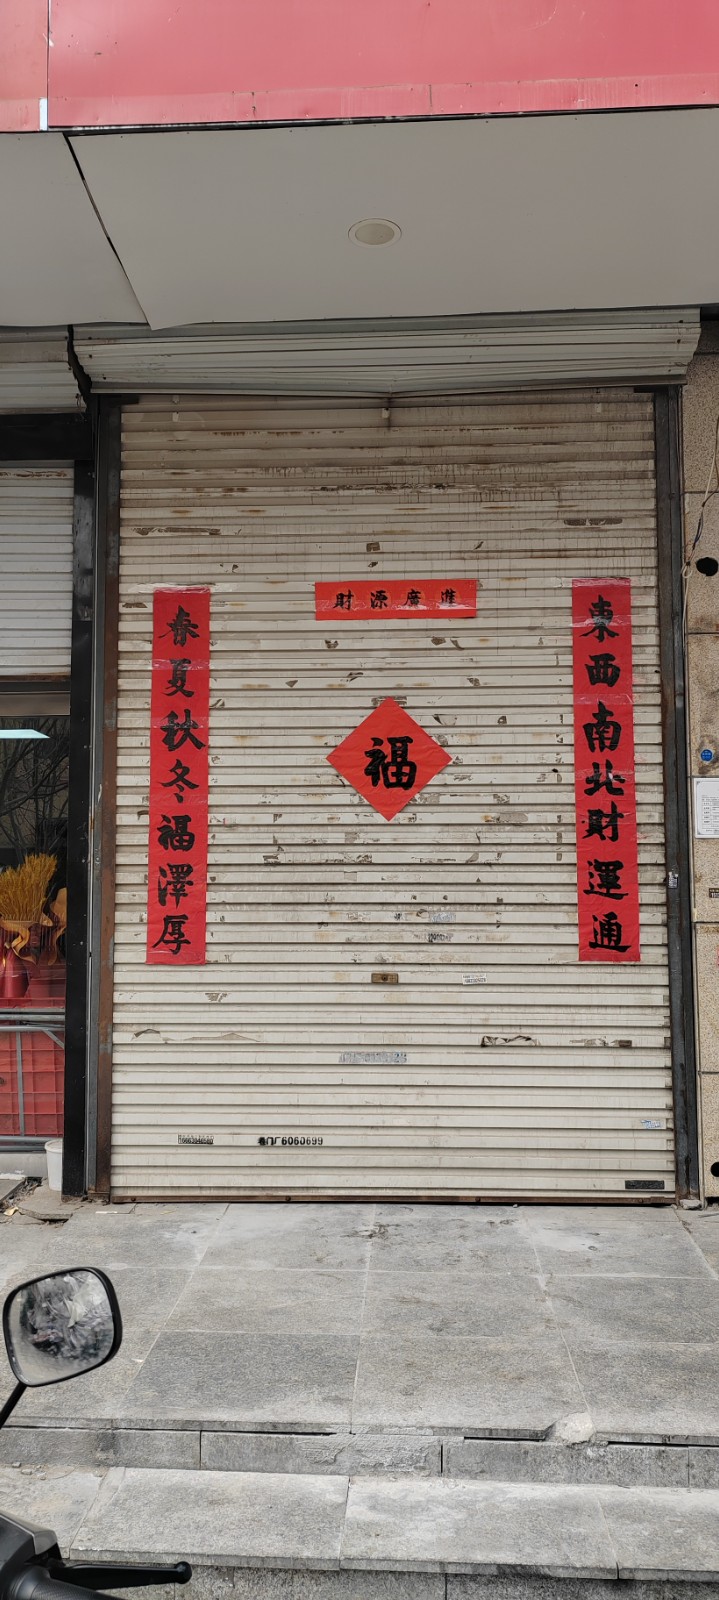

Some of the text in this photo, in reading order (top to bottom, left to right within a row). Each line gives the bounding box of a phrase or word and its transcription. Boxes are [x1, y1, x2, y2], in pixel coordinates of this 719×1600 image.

[333, 588, 461, 611] 財源廣進
[152, 605, 206, 955] 春夏秋冬福澤厚
[364, 735, 418, 791] 福
[578, 594, 632, 952] 東西南北財運通
